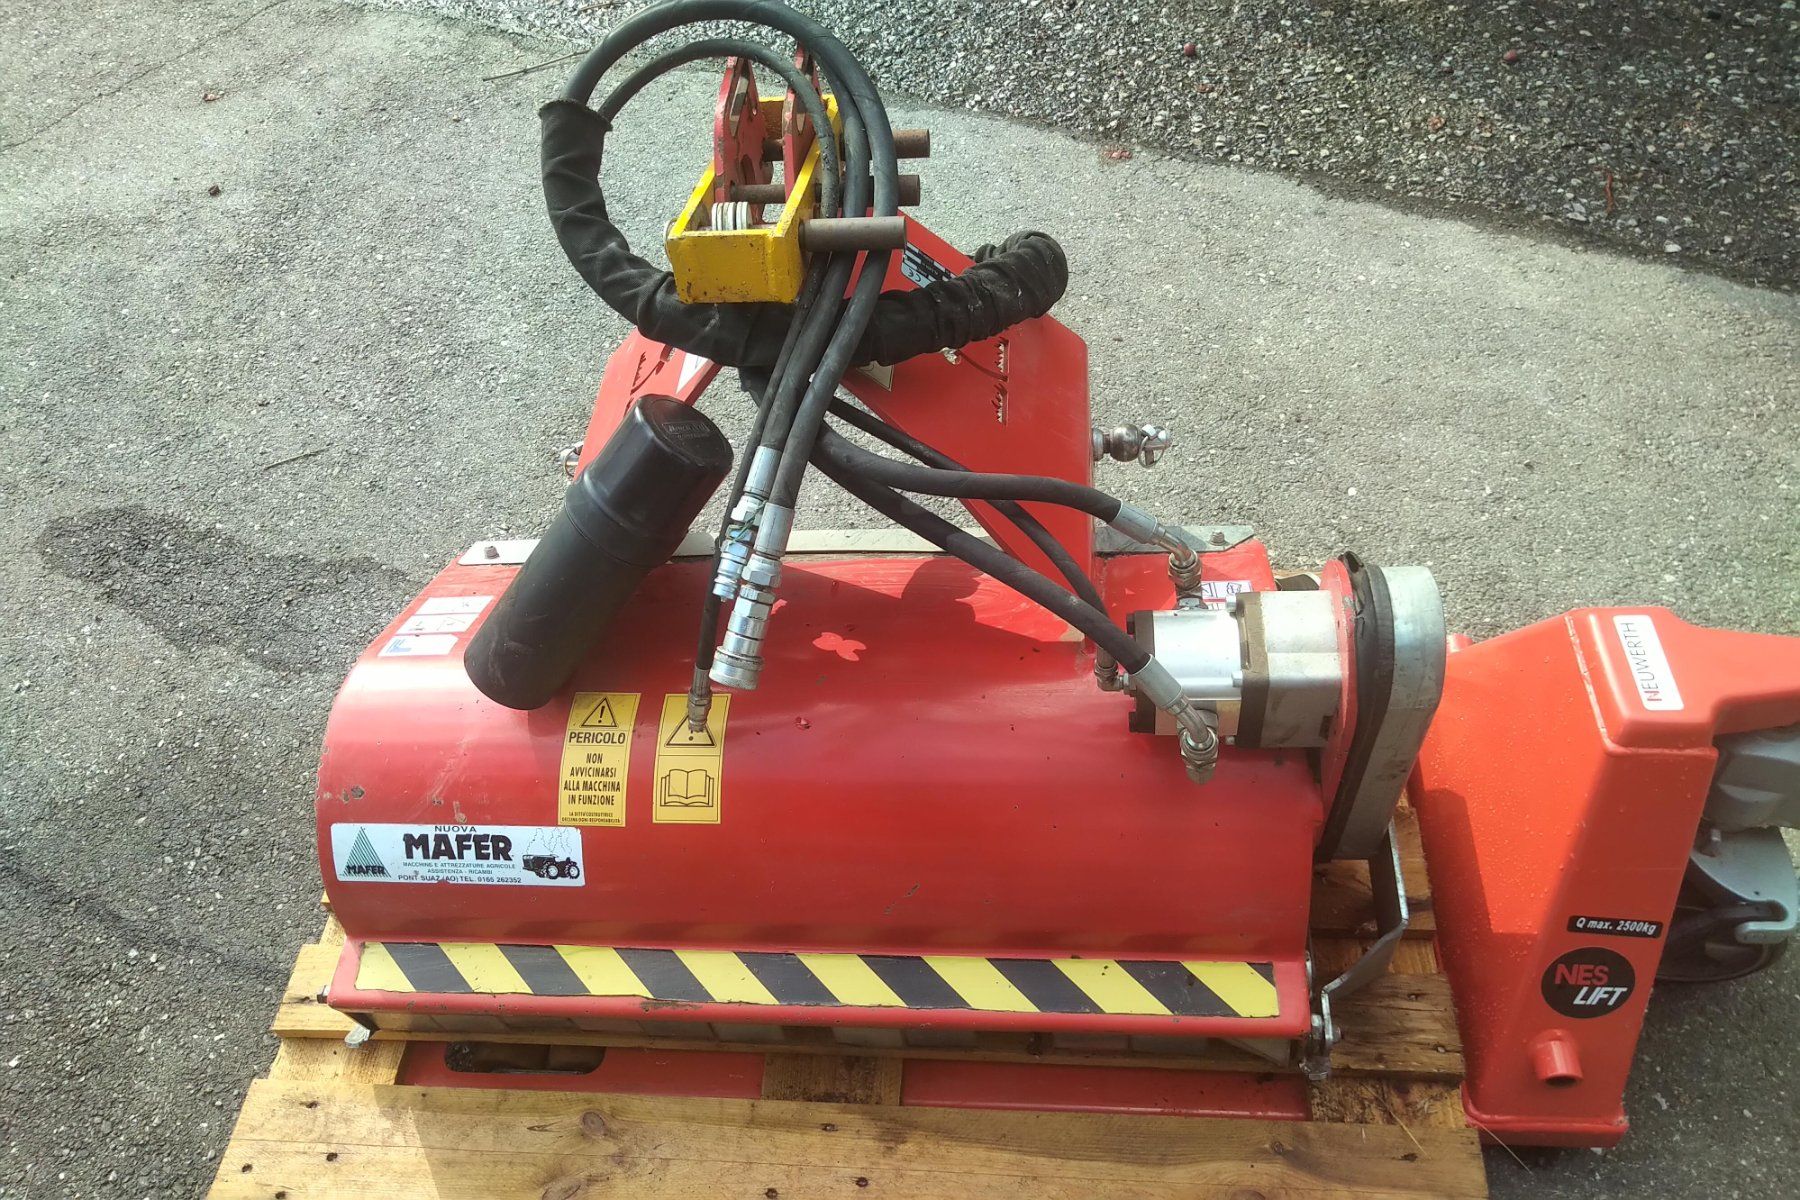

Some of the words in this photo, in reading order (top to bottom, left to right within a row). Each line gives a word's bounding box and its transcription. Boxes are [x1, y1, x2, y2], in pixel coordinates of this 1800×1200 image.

[1620, 622, 1662, 702] NEUWERTH
[568, 731, 626, 745] PERICOLO
[586, 752, 603, 764] NON
[569, 766, 617, 777] AVVICINARSI
[563, 780, 580, 792] ALLA
[582, 780, 621, 793] MACCHINA
[568, 794, 577, 805] IN
[578, 794, 615, 806] FUNZIONE
[434, 825, 477, 833] NUOVA
[403, 832, 514, 862] MAFER
[346, 864, 386, 876] MAFER
[1576, 917, 1585, 929] Q
[1587, 920, 1613, 930] max.
[1616, 920, 1658, 935] 2500kg
[1554, 963, 1610, 986] NES
[1573, 986, 1628, 1006] LIFT
